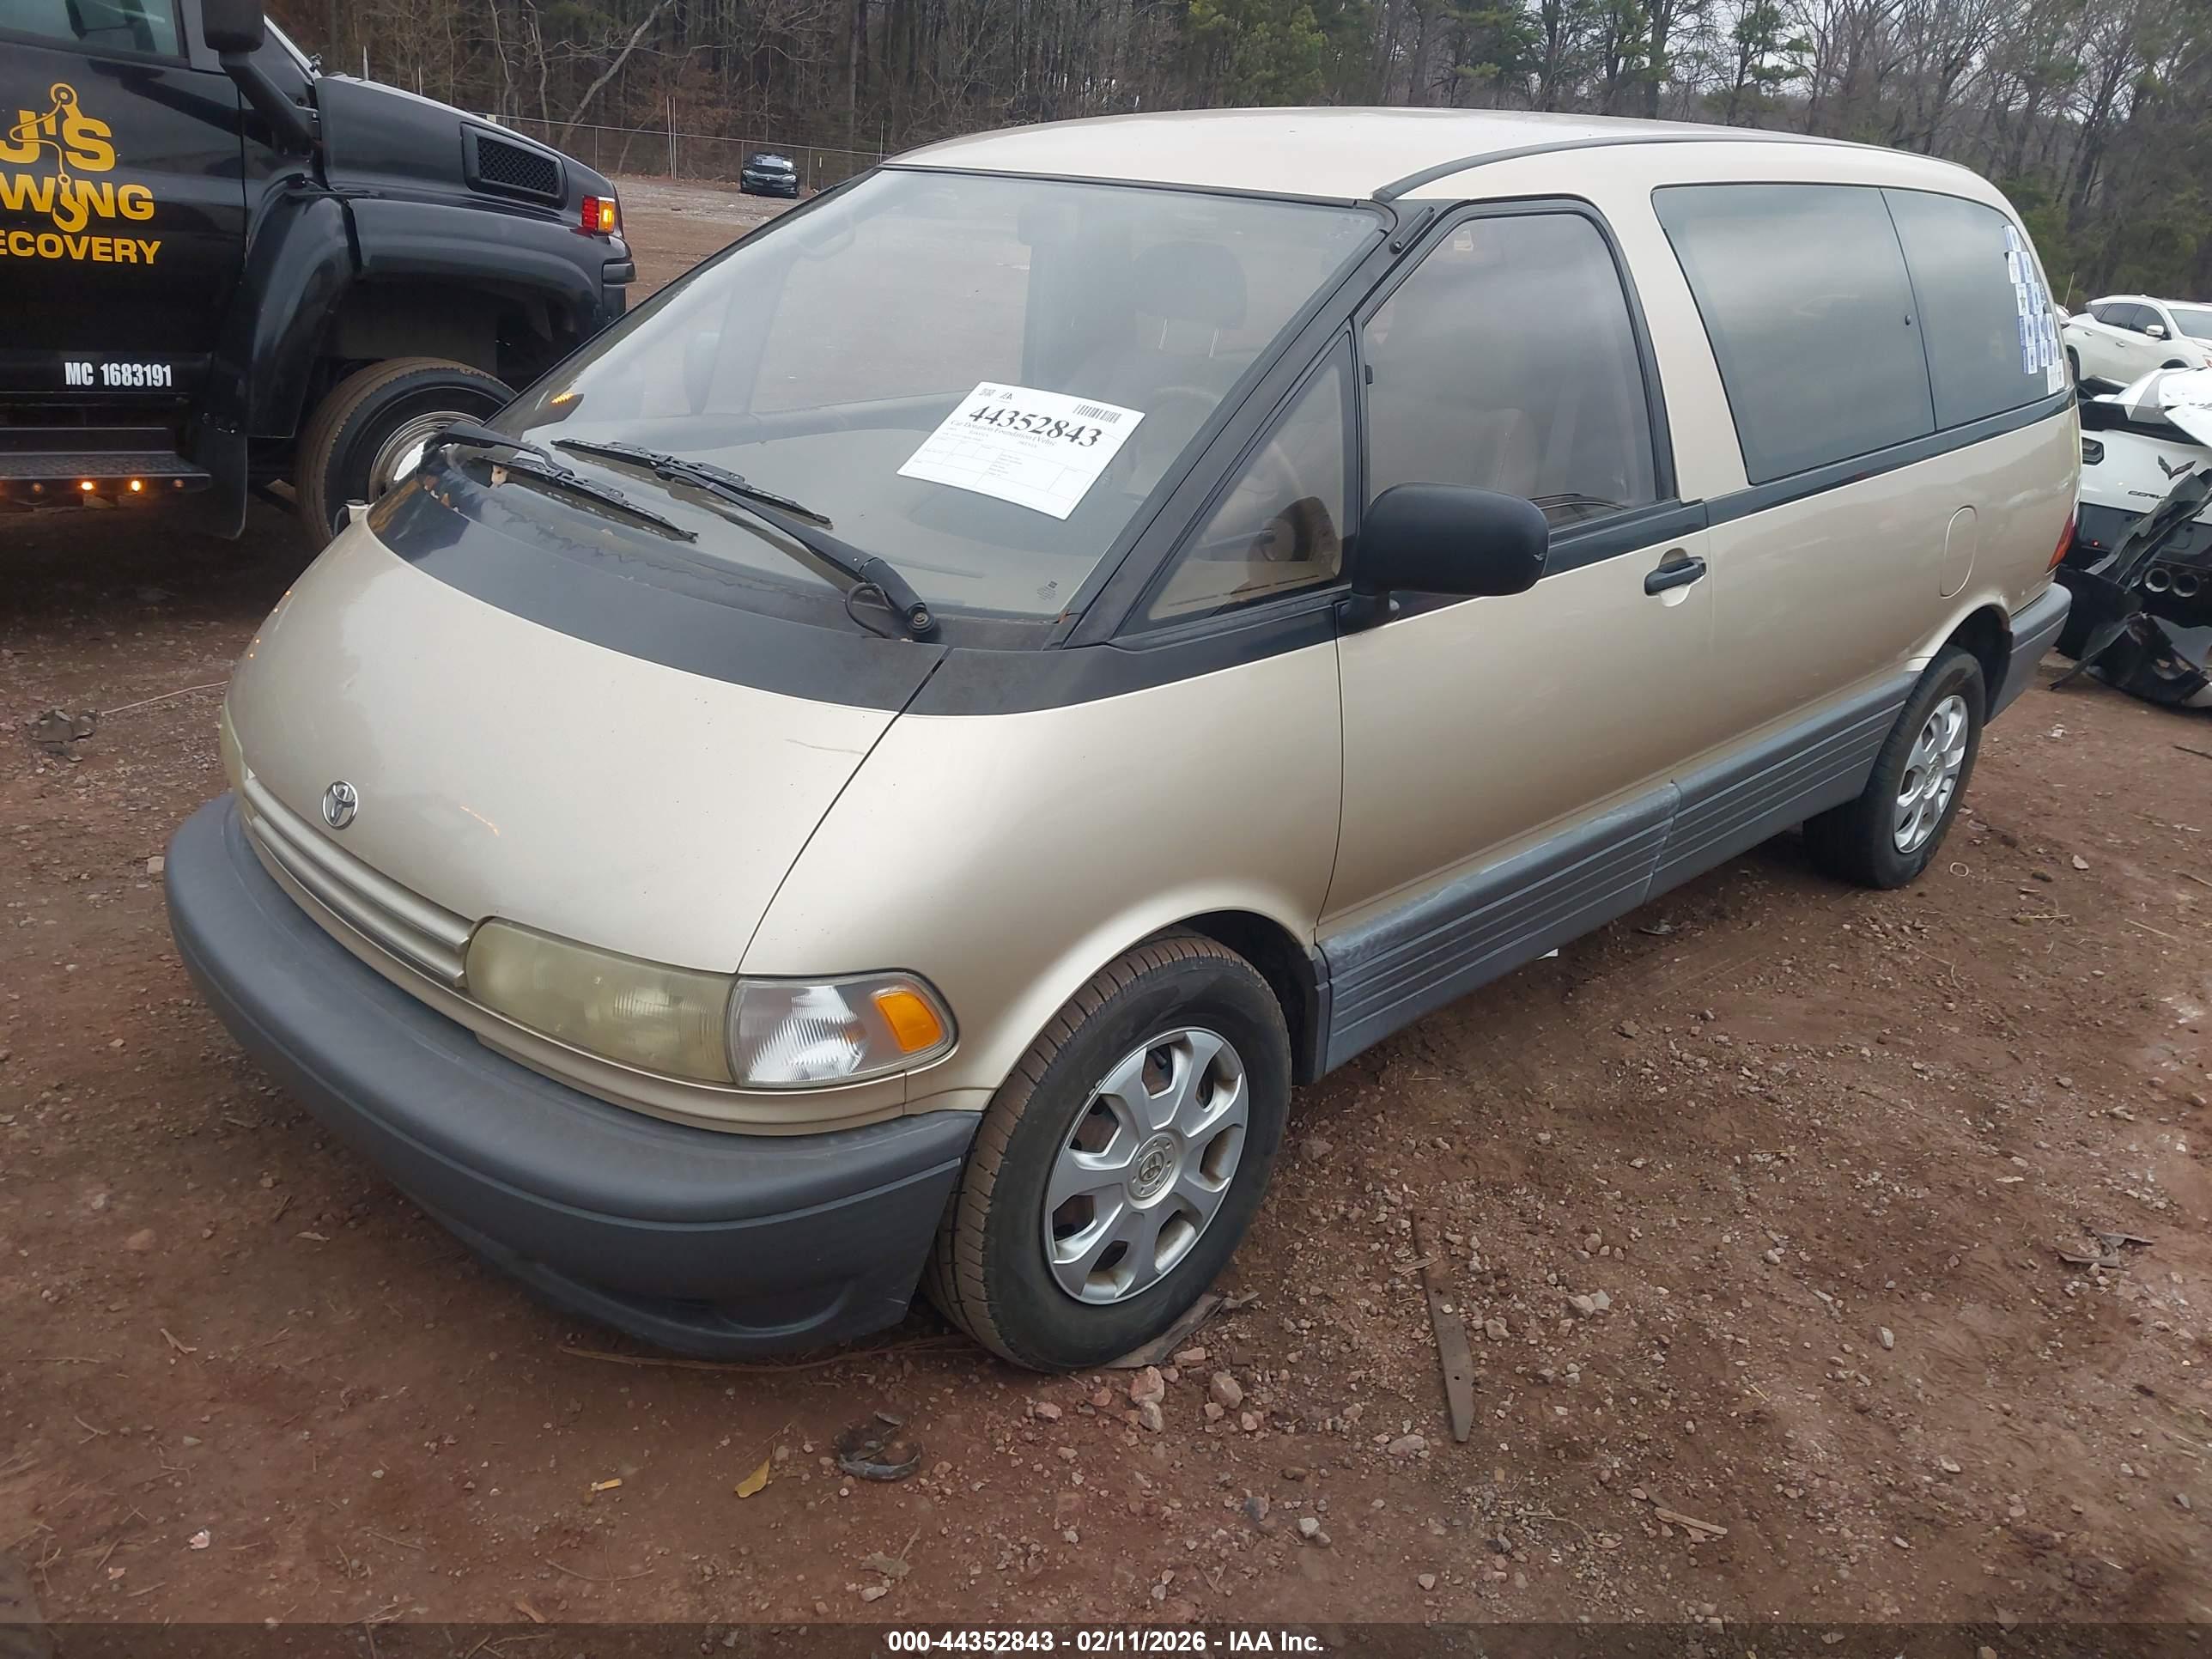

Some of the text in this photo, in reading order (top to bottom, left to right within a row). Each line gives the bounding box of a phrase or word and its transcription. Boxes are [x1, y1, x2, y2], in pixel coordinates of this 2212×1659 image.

[64, 362, 172, 386] MC 1683191
[969, 405, 1102, 447] 44352843
